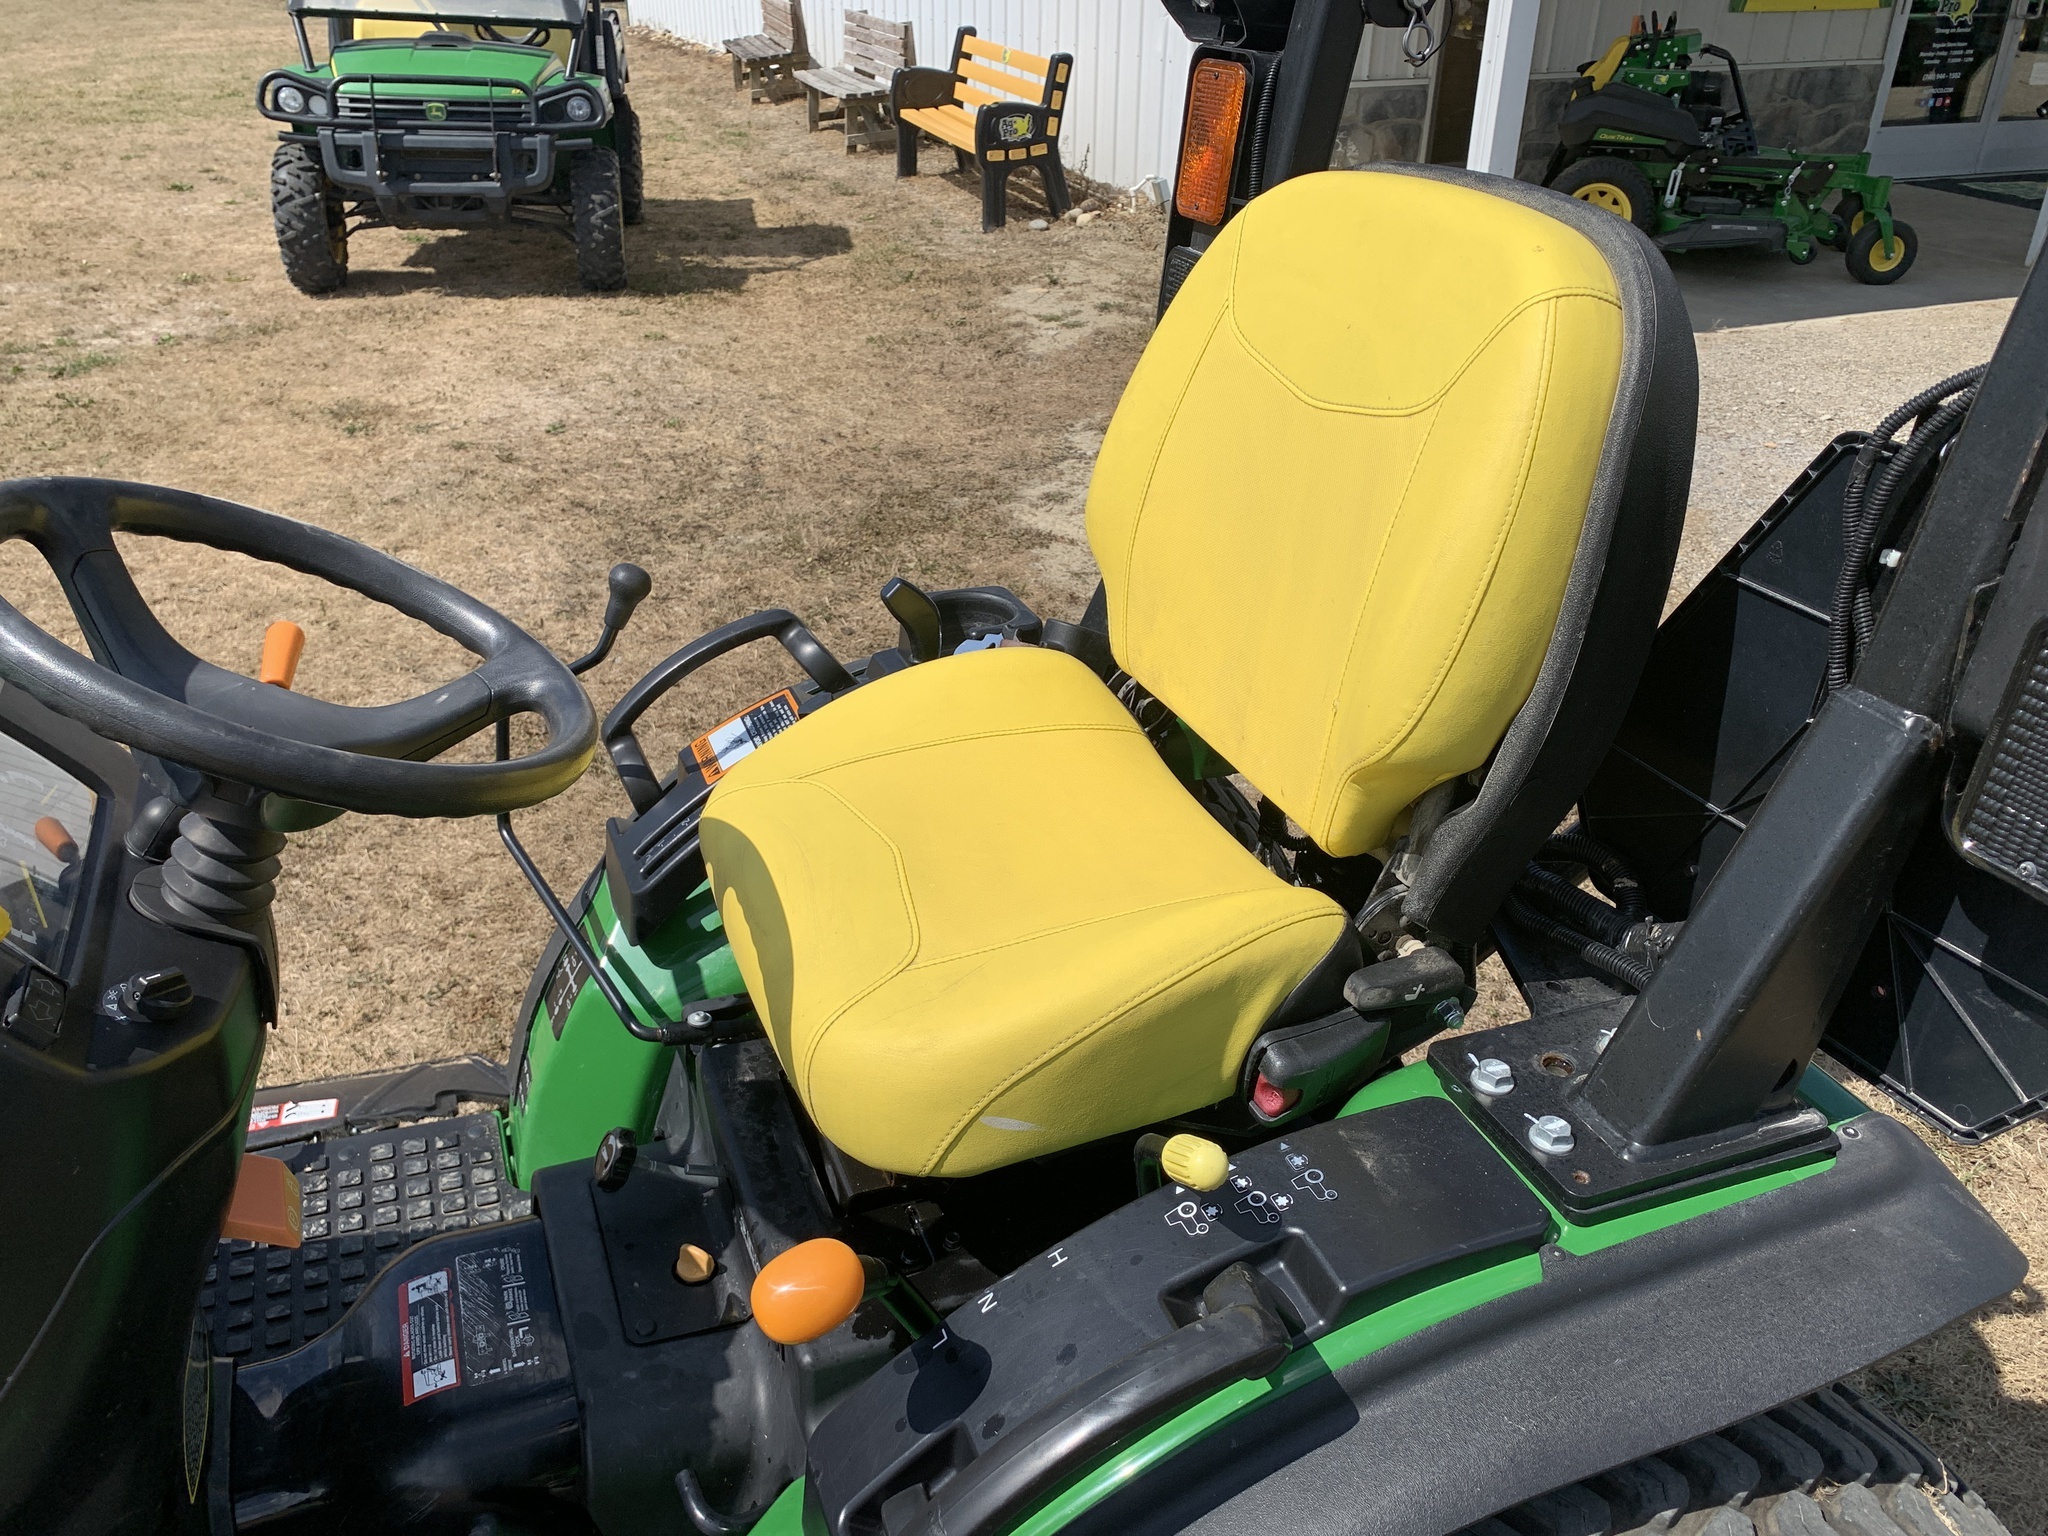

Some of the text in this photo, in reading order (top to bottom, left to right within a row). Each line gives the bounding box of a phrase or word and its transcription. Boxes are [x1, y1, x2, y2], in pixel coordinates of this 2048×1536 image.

[695, 738, 718, 773] WARNING
[1047, 1247, 1068, 1268] H
[977, 1292, 998, 1313] N
[402, 1322, 410, 1350] DANGER
[932, 1328, 948, 1350] L
